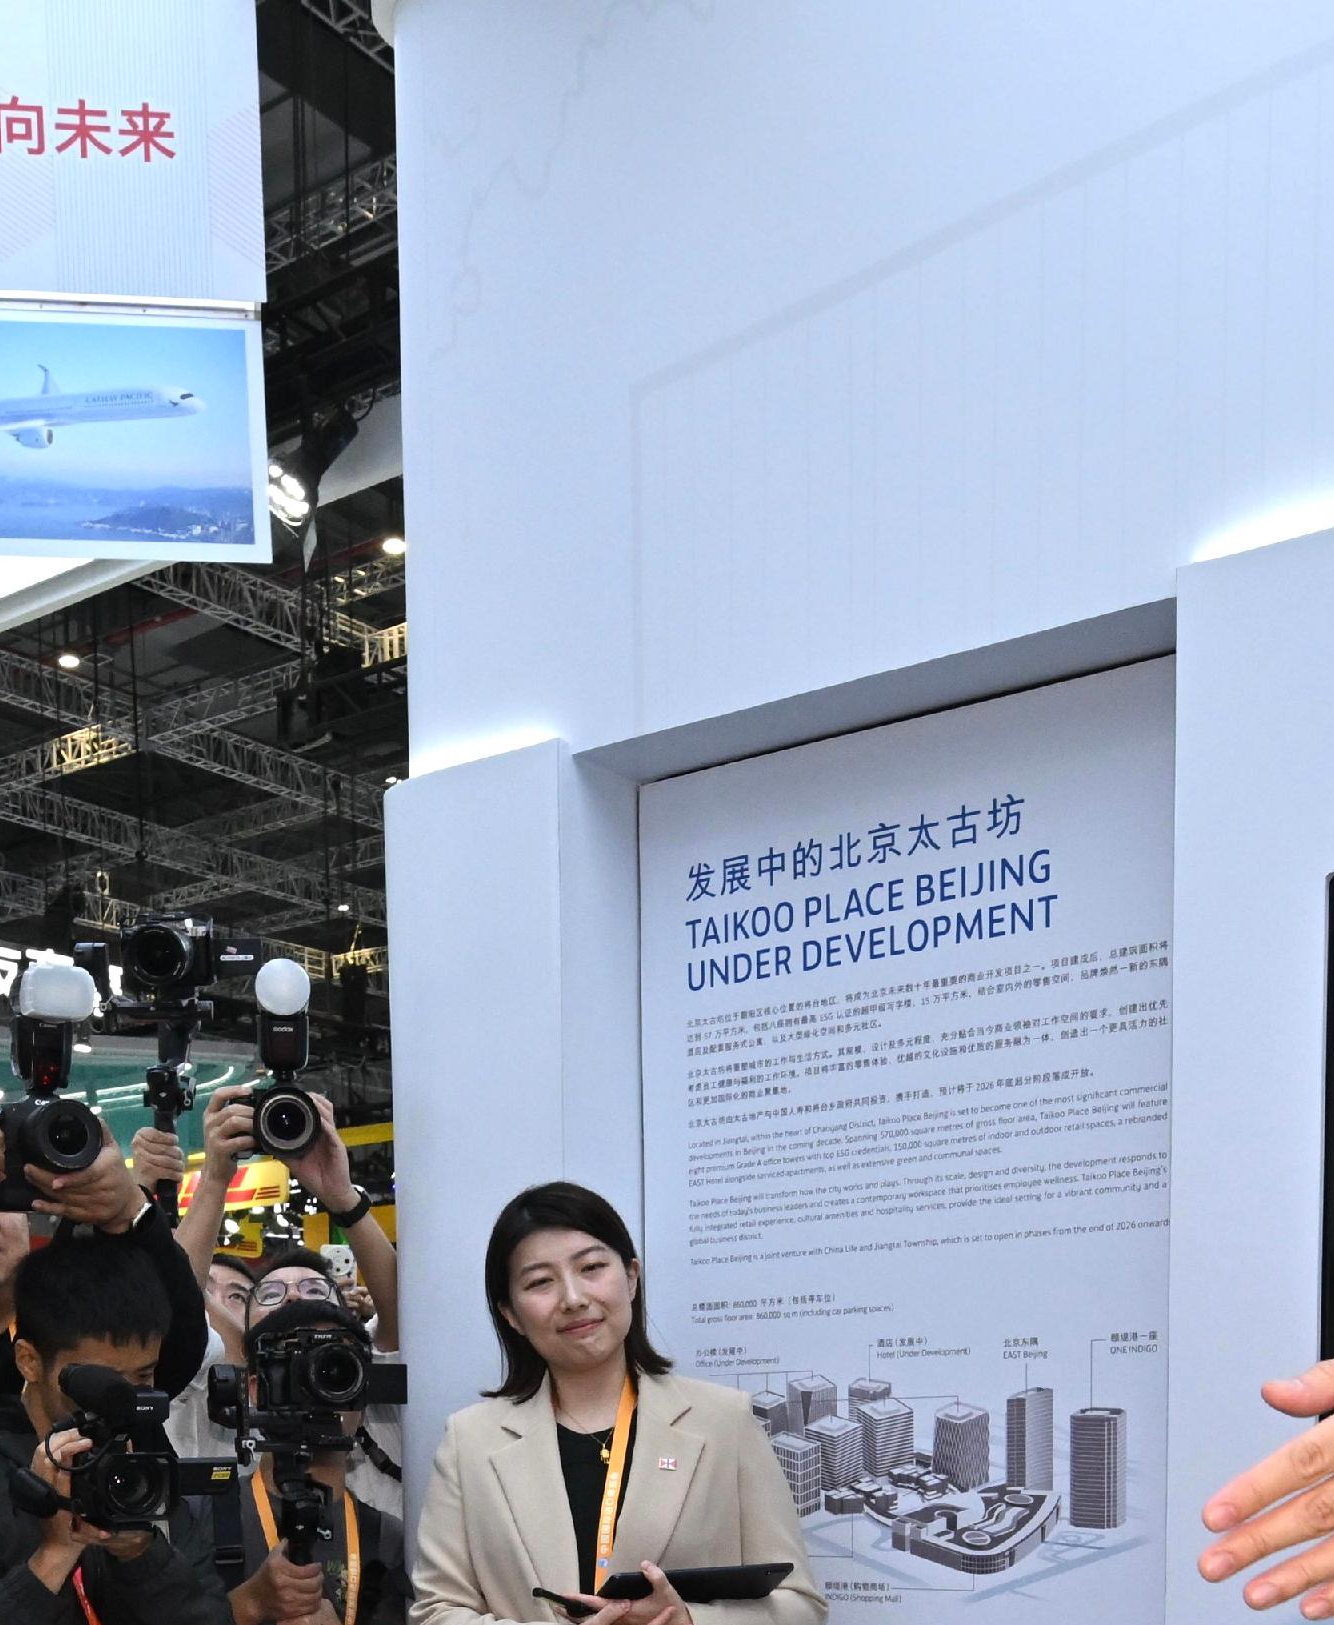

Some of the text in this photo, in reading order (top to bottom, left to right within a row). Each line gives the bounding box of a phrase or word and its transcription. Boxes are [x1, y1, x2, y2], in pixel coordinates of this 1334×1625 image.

[685, 793, 1025, 902] 发展中的北京太古坊
[685, 849, 1051, 949] TAIKOO PLACE BEIJING
[687, 894, 1058, 991] UNDER DEVELOPMENT
[743, 1146, 765, 1156] Beijing
[788, 1140, 813, 1151] coming
[845, 1132, 877, 1144] Spanning
[911, 1127, 935, 1137] square
[937, 1122, 963, 1132] metres
[976, 1120, 996, 1129] gross
[998, 1116, 1015, 1125] floor
[1040, 1110, 1065, 1120] Taikoo
[1067, 1107, 1089, 1117] Place
[1122, 1102, 1135, 1110] will
[1137, 1098, 1167, 1108] feature
[750, 1132, 770, 1141] within
[902, 1113, 921, 1123] Place
[923, 1110, 948, 1121] Beijing
[980, 1102, 1011, 1113] become
[1054, 1094, 1074, 1104] most
[1076, 1089, 1117, 1103] significant
[1119, 1083, 1167, 1096] commercial
[736, 1160, 755, 1169] Grade
[763, 1157, 781, 1166] office
[782, 1154, 805, 1163] towers
[924, 1139, 948, 1149] square
[950, 1134, 977, 1144] metres
[1031, 1125, 1062, 1135] outdoor
[1086, 1120, 1116, 1131] spaces,
[1124, 1112, 1167, 1125] rebranded
[688, 1178, 704, 1187] EAST
[837, 1162, 850, 1171] well
[896, 1156, 917, 1166] green
[908, 1169, 1130, 1200] workspace that employee Taikoo Place
[968, 1169, 993, 1180] design
[1064, 1156, 1116, 1170] development
[1118, 1152, 1156, 1165] responds
[948, 1198, 976, 1210] provide
[1014, 1192, 1041, 1204] setting
[1064, 1187, 1092, 1197] vibrant
[1094, 1183, 1141, 1196] community
[711, 1255, 728, 1263] Place
[940, 1236, 962, 1245] which
[994, 1233, 1013, 1242] open
[1116, 1221, 1136, 1230] 2026
[876, 1351, 895, 1359] Hotel
[1003, 1350, 1021, 1359] EAST
